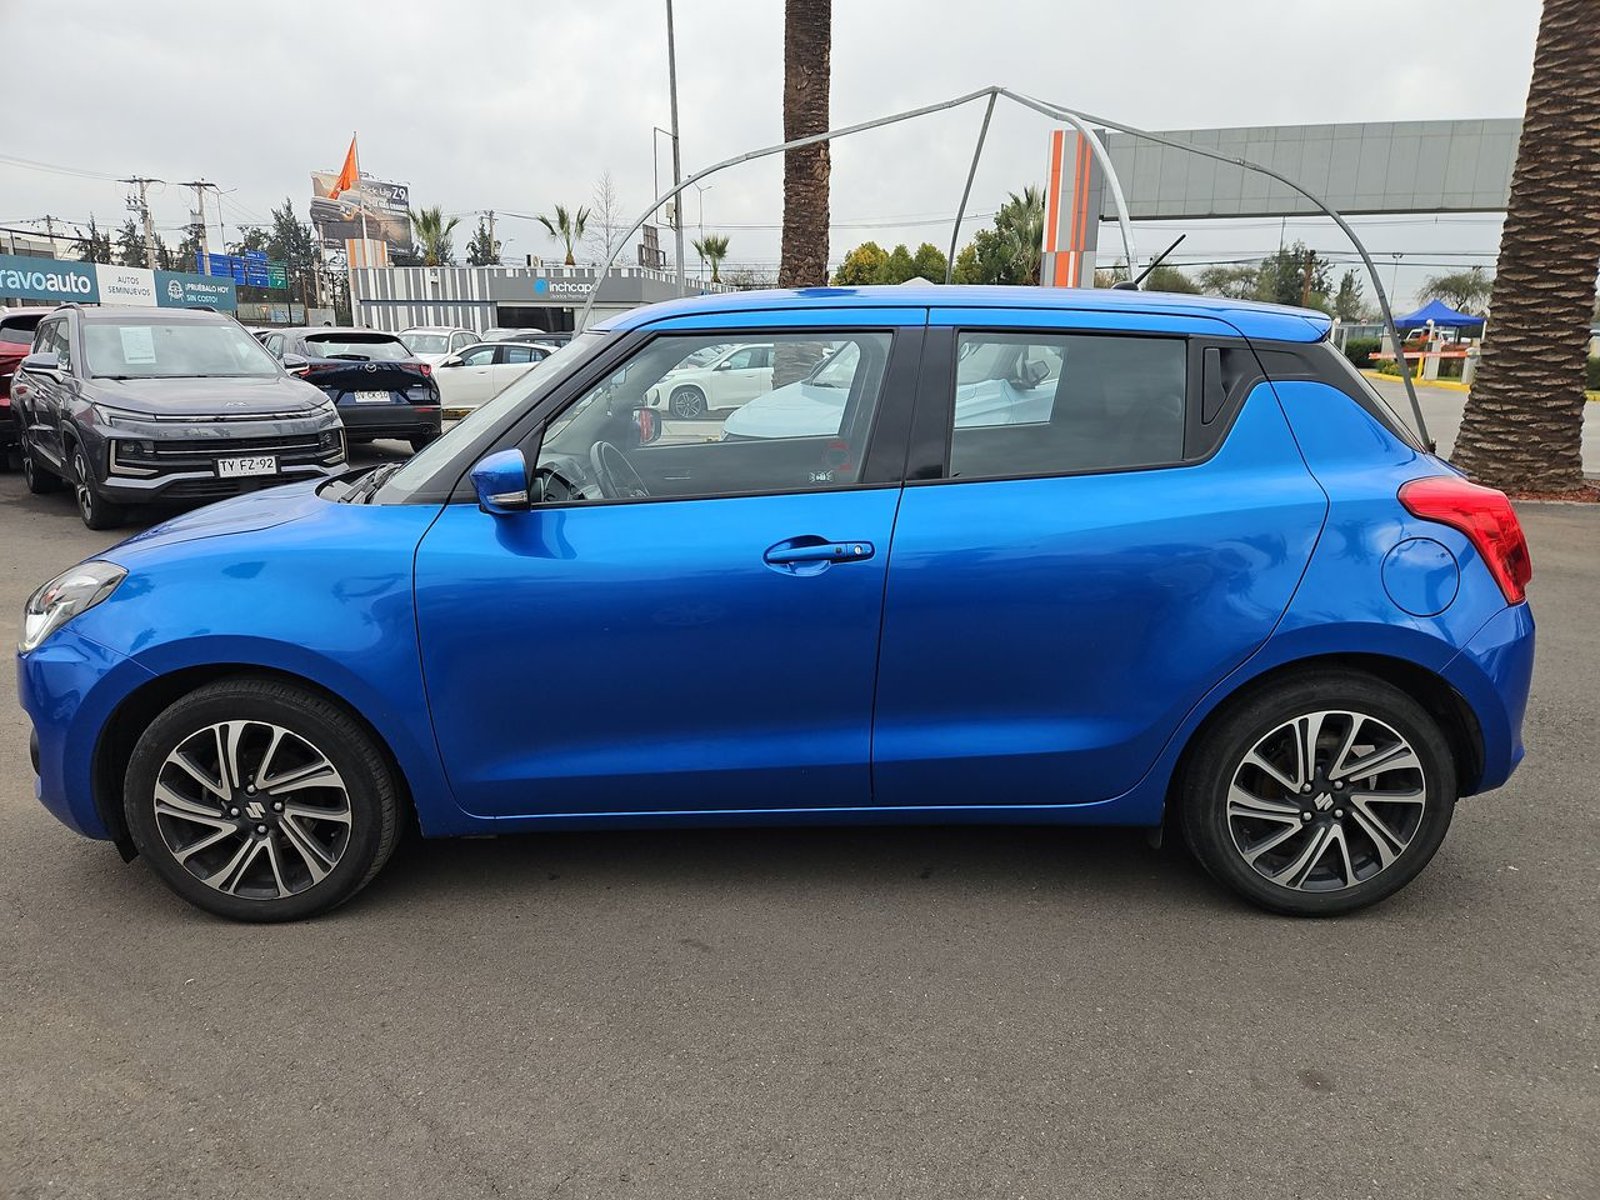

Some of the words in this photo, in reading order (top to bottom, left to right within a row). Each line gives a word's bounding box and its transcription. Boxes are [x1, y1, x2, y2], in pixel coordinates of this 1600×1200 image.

[391, 186, 406, 200] Z9
[118, 276, 140, 285] AUTOS
[107, 285, 151, 296] SEMINUEVOS
[217, 285, 229, 294] HOY
[549, 281, 595, 294] inchcap
[186, 294, 197, 302] SIN
[219, 460, 235, 472] TY
